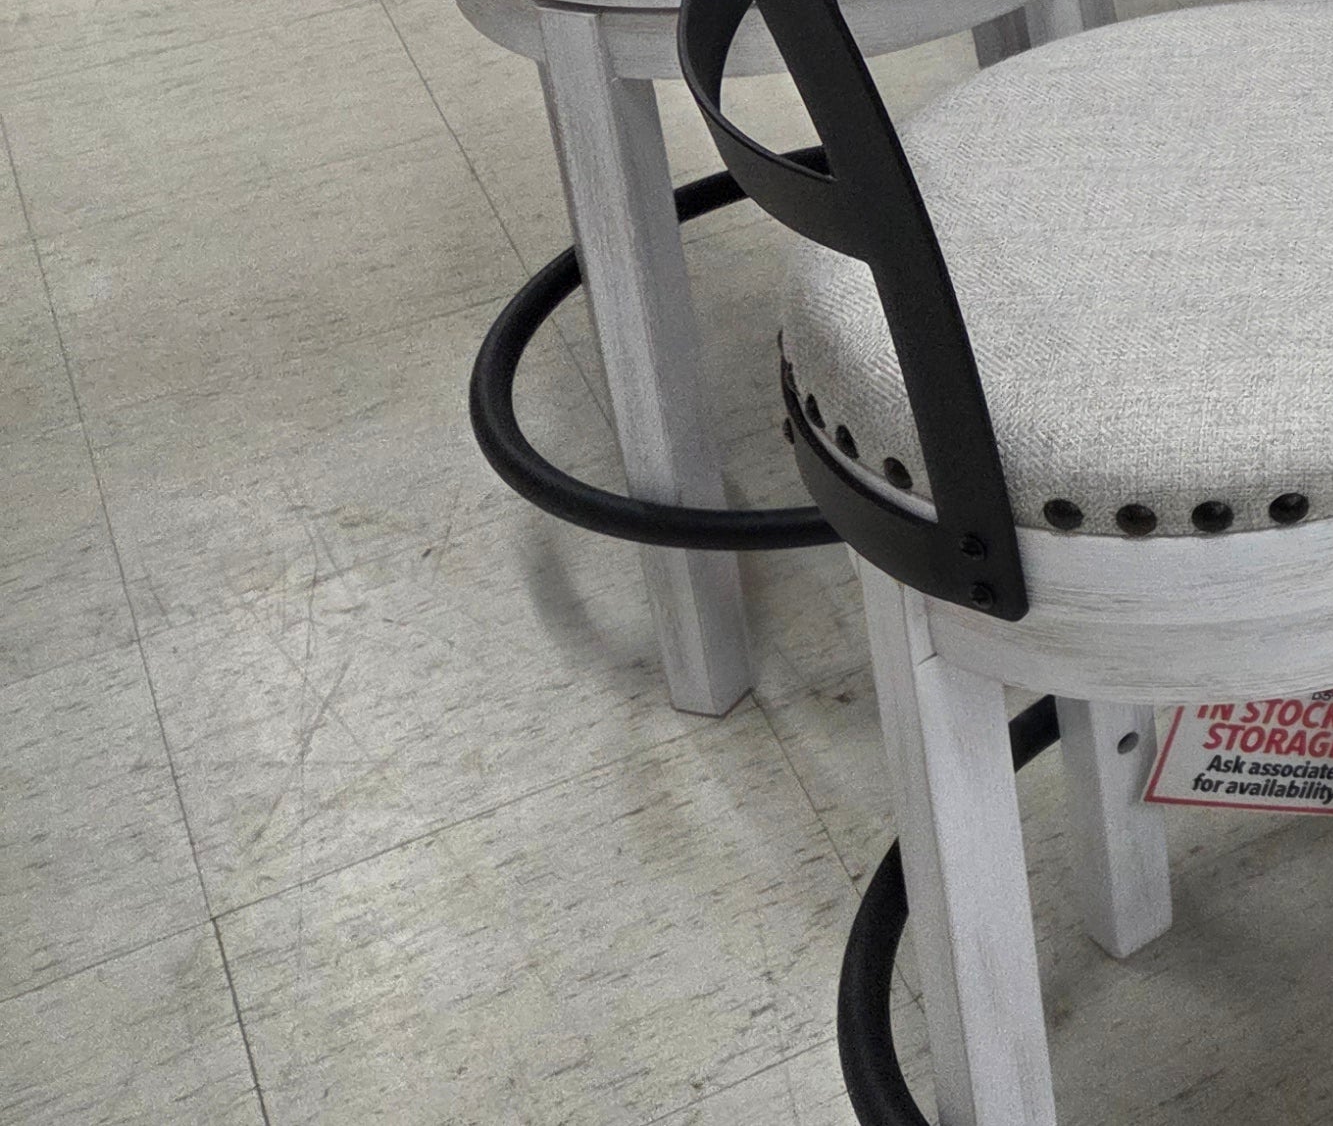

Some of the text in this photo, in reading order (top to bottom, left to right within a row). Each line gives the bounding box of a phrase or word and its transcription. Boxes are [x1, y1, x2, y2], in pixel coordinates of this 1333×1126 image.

[1196, 703, 1233, 721] IN
[1206, 754, 1245, 774] Ask
[1192, 773, 1224, 793] for
